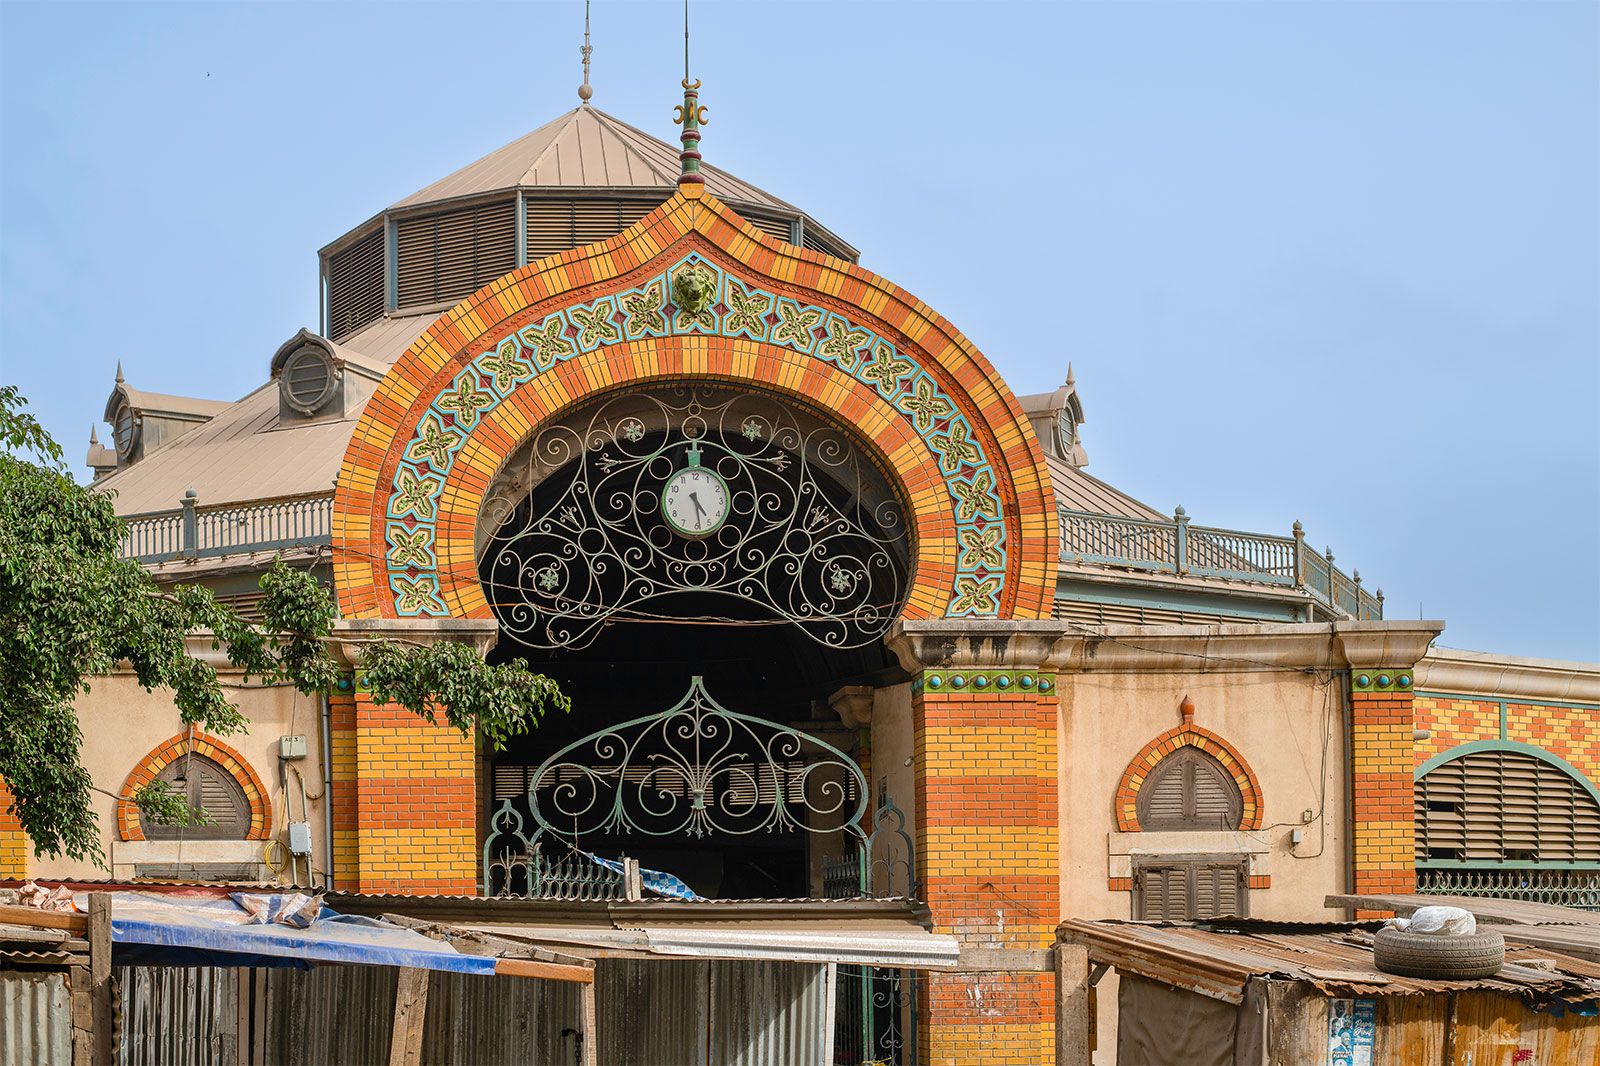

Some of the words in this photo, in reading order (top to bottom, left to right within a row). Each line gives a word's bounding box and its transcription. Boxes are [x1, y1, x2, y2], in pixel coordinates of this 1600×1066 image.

[671, 485, 679, 493] 10
[715, 485, 720, 493] 2
[681, 519, 686, 527] 7
[694, 522, 700, 530] 6
